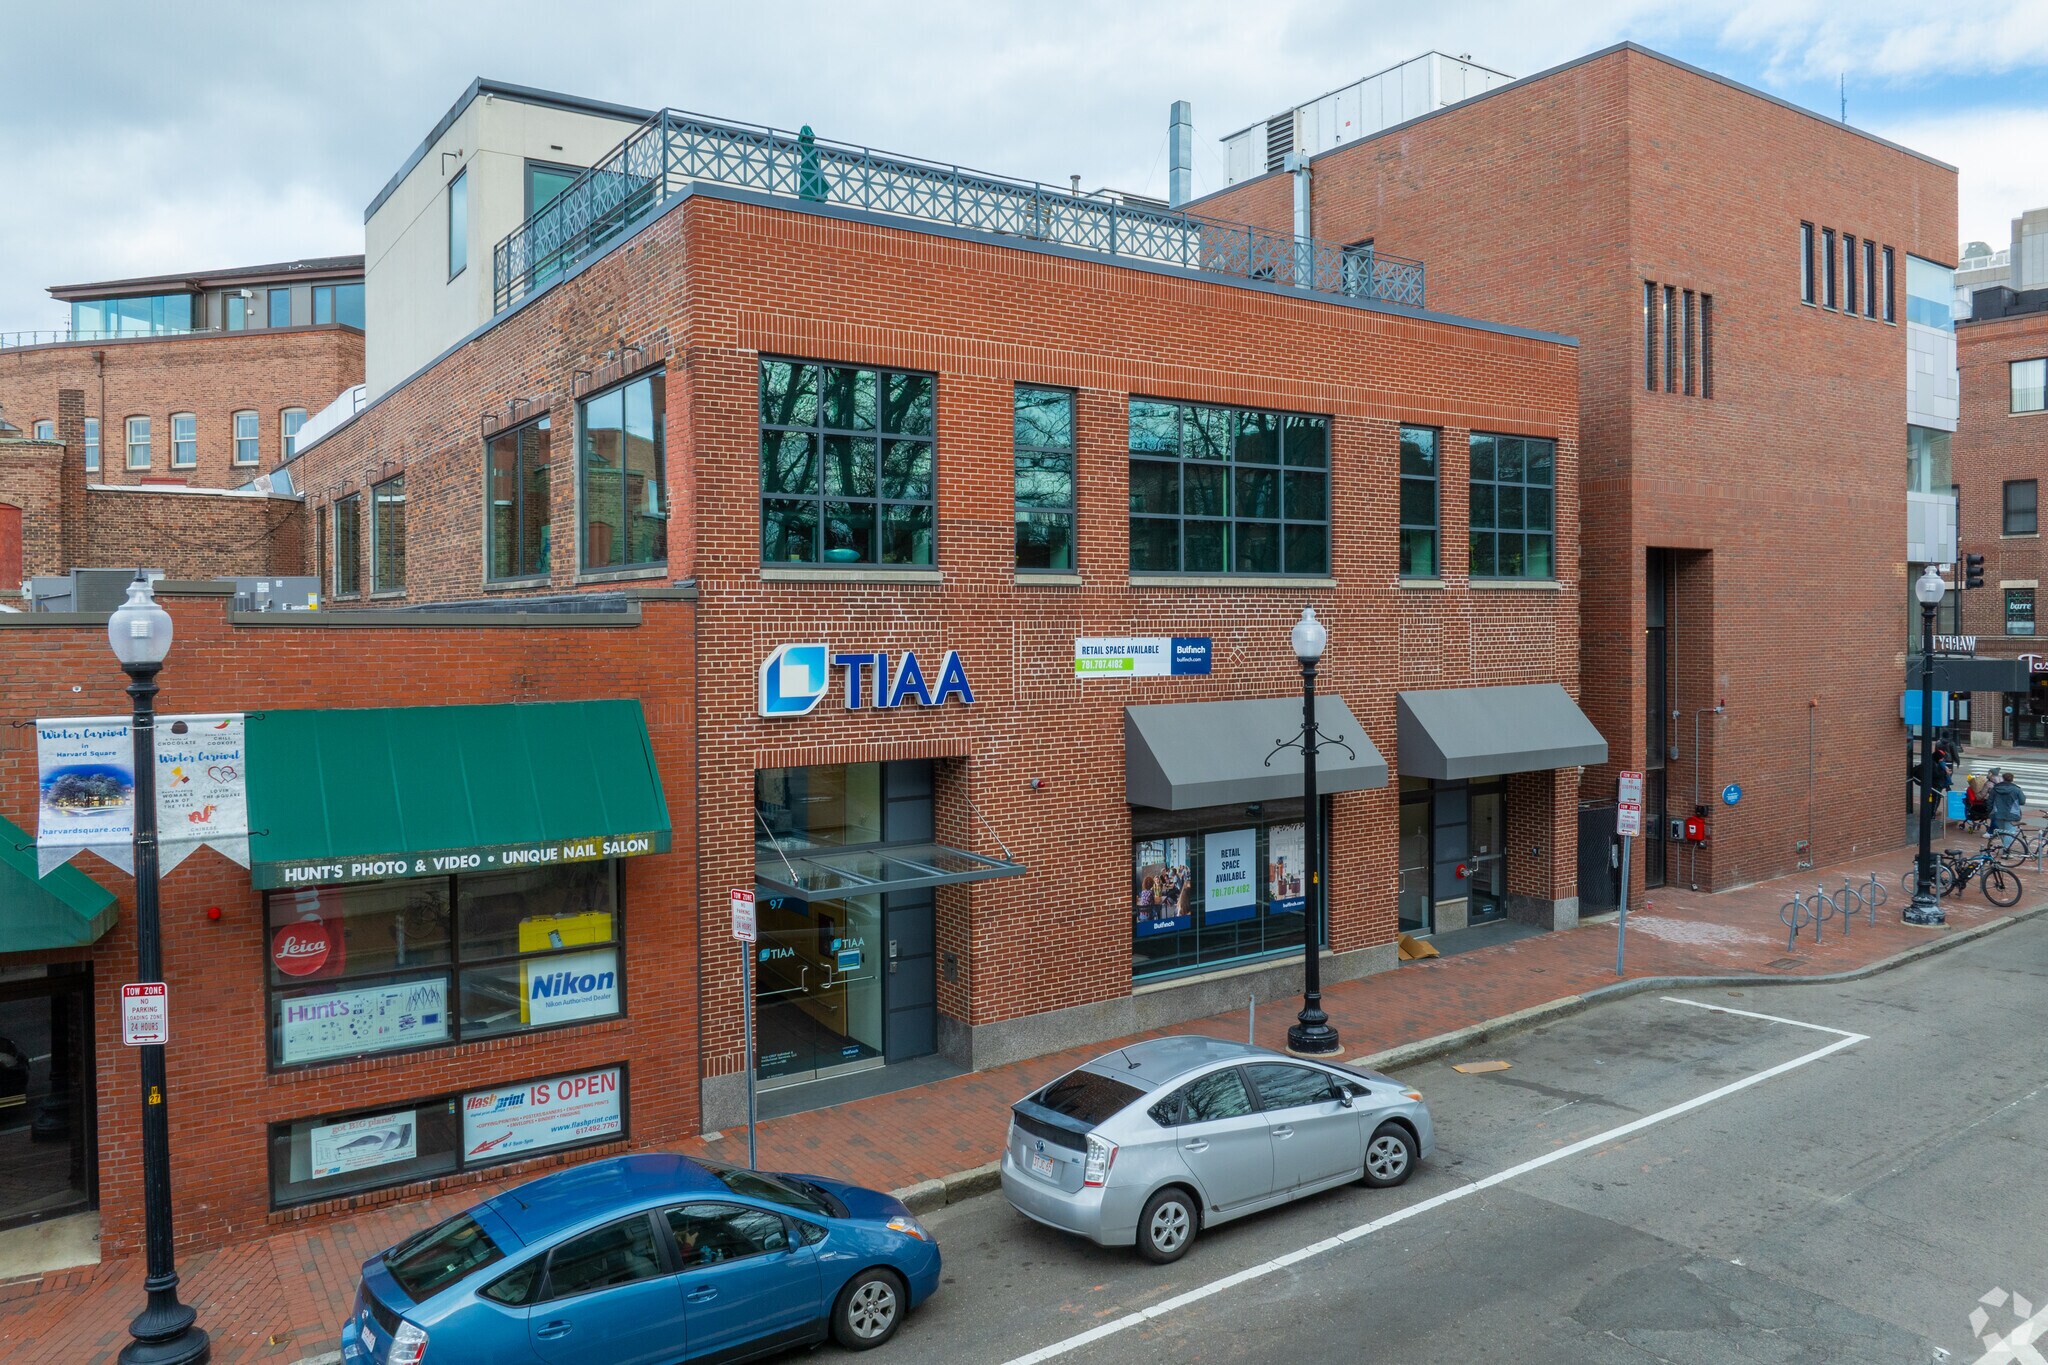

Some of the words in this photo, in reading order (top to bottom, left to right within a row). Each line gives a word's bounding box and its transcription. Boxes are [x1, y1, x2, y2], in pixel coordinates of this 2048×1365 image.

[1082, 646, 1104, 654] RETAIL
[1106, 646, 1125, 654] SPACE
[1126, 645, 1160, 654] AVAILABLE
[1176, 645, 1206, 654] Bulfinch
[830, 650, 975, 710] TIAA
[42, 729, 80, 740] Winter
[84, 726, 128, 738] Carnival
[159, 752, 194, 763] Winter
[198, 750, 240, 761] Carnival
[42, 826, 130, 834] harvardsquare.com
[1221, 848, 1240, 858] RETAIL
[284, 864, 344, 882] HUNT'S
[352, 860, 407, 877] PHOTO
[414, 860, 427, 872] &
[432, 854, 480, 870] VIDEO
[502, 847, 558, 865] UNIQUE
[563, 843, 596, 859] NAIL
[602, 838, 649, 855] SALON
[1222, 860, 1240, 870] SPACE
[1216, 872, 1246, 883] AVAILABLE
[770, 898, 783, 909] 97
[1154, 920, 1174, 929] Bulfinch
[276, 936, 326, 958] Leica
[842, 937, 865, 949] TIAA
[771, 947, 795, 959] TIAA
[126, 987, 140, 996] TOW
[144, 986, 162, 995] ZONE
[532, 971, 614, 1000] Nikon
[545, 1000, 562, 1008] Nikon
[563, 994, 592, 1006] Authorized
[288, 1000, 350, 1023] Hunt's
[131, 1022, 138, 1031] 24
[141, 1022, 158, 1031] HOURS
[530, 1085, 550, 1106] IS
[557, 1072, 615, 1101] OPEN
[150, 1095, 159, 1104] 27
[349, 1120, 366, 1129] BIG
[551, 1114, 618, 1132] www.flashprint.com
